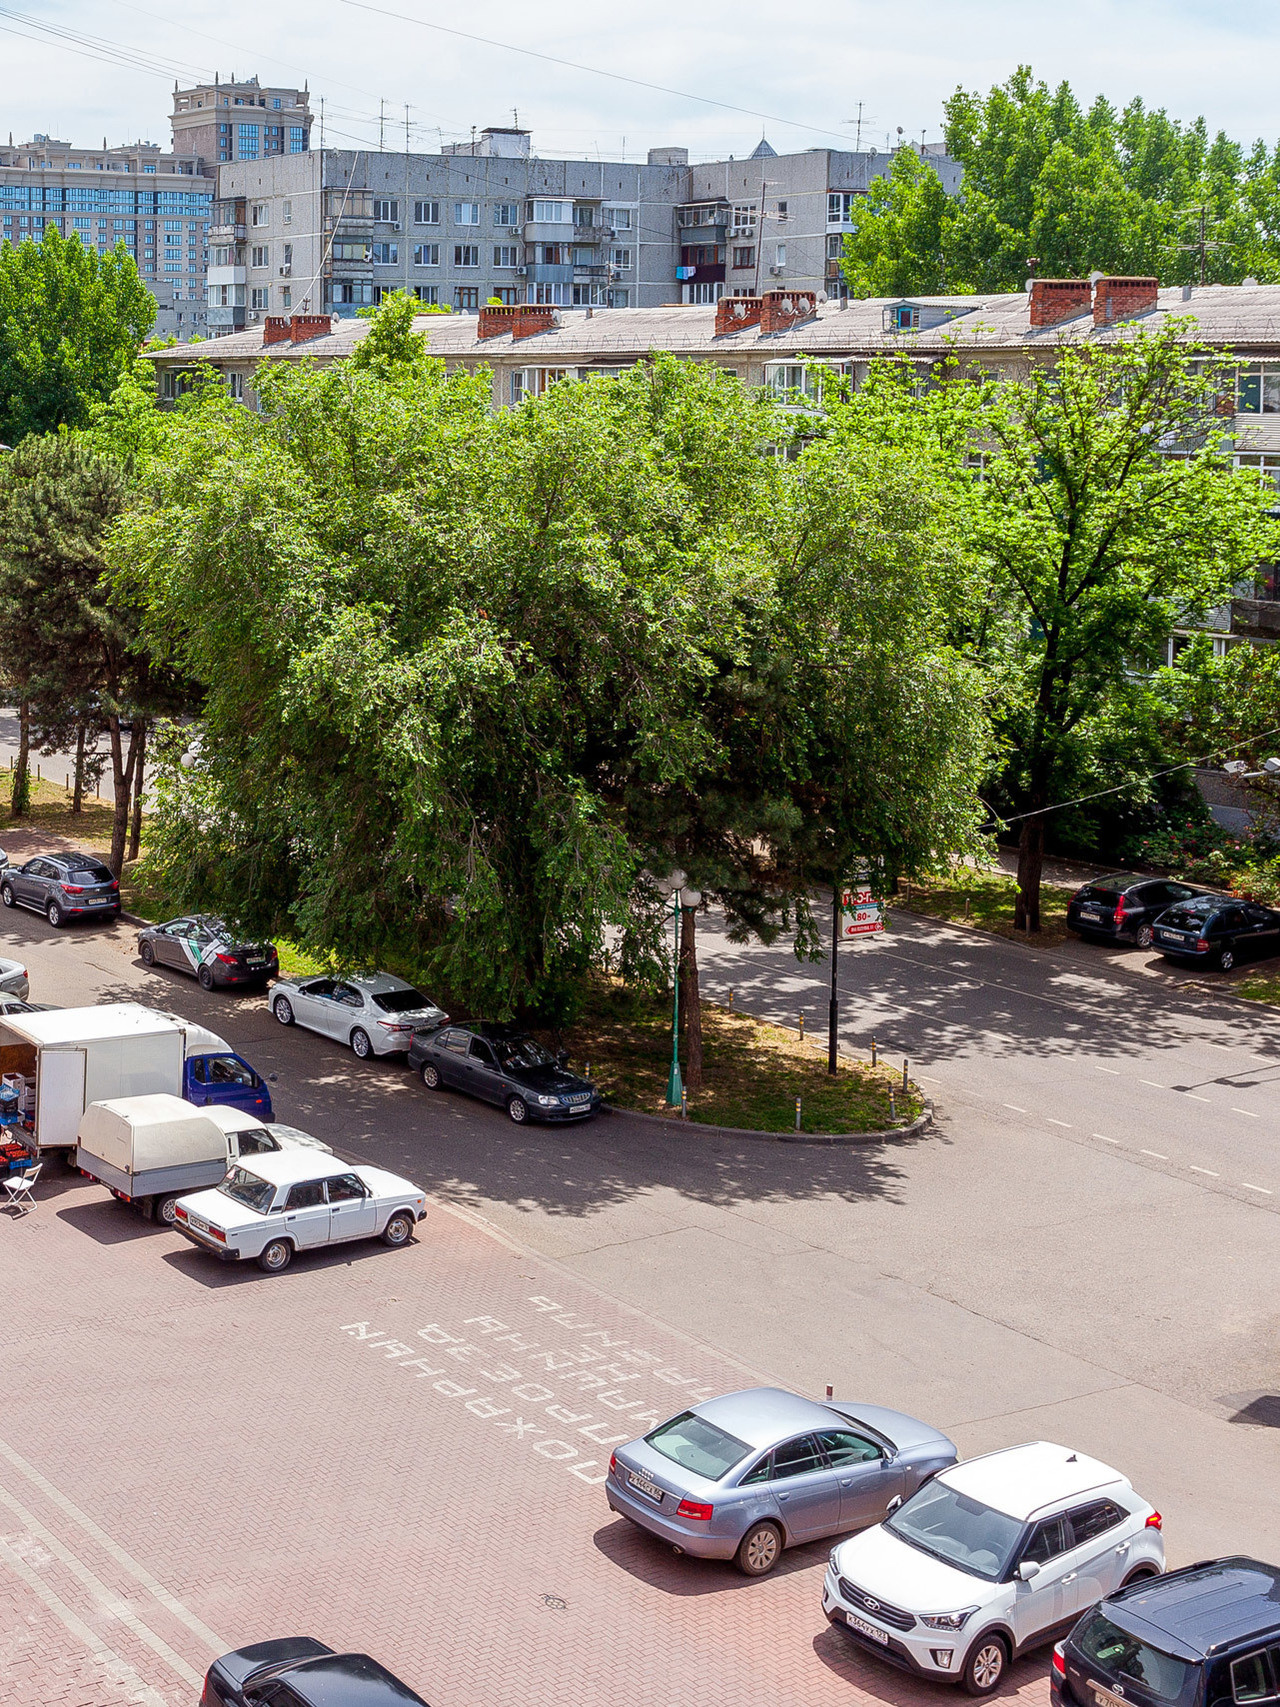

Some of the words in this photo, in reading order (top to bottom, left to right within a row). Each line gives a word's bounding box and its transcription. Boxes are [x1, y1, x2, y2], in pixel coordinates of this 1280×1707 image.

[339, 1321, 608, 1484] ПОЖАРНЫЙ
[417, 1324, 628, 1444] ПРОЕЗД
[569, 1344, 641, 1383] НЕ
